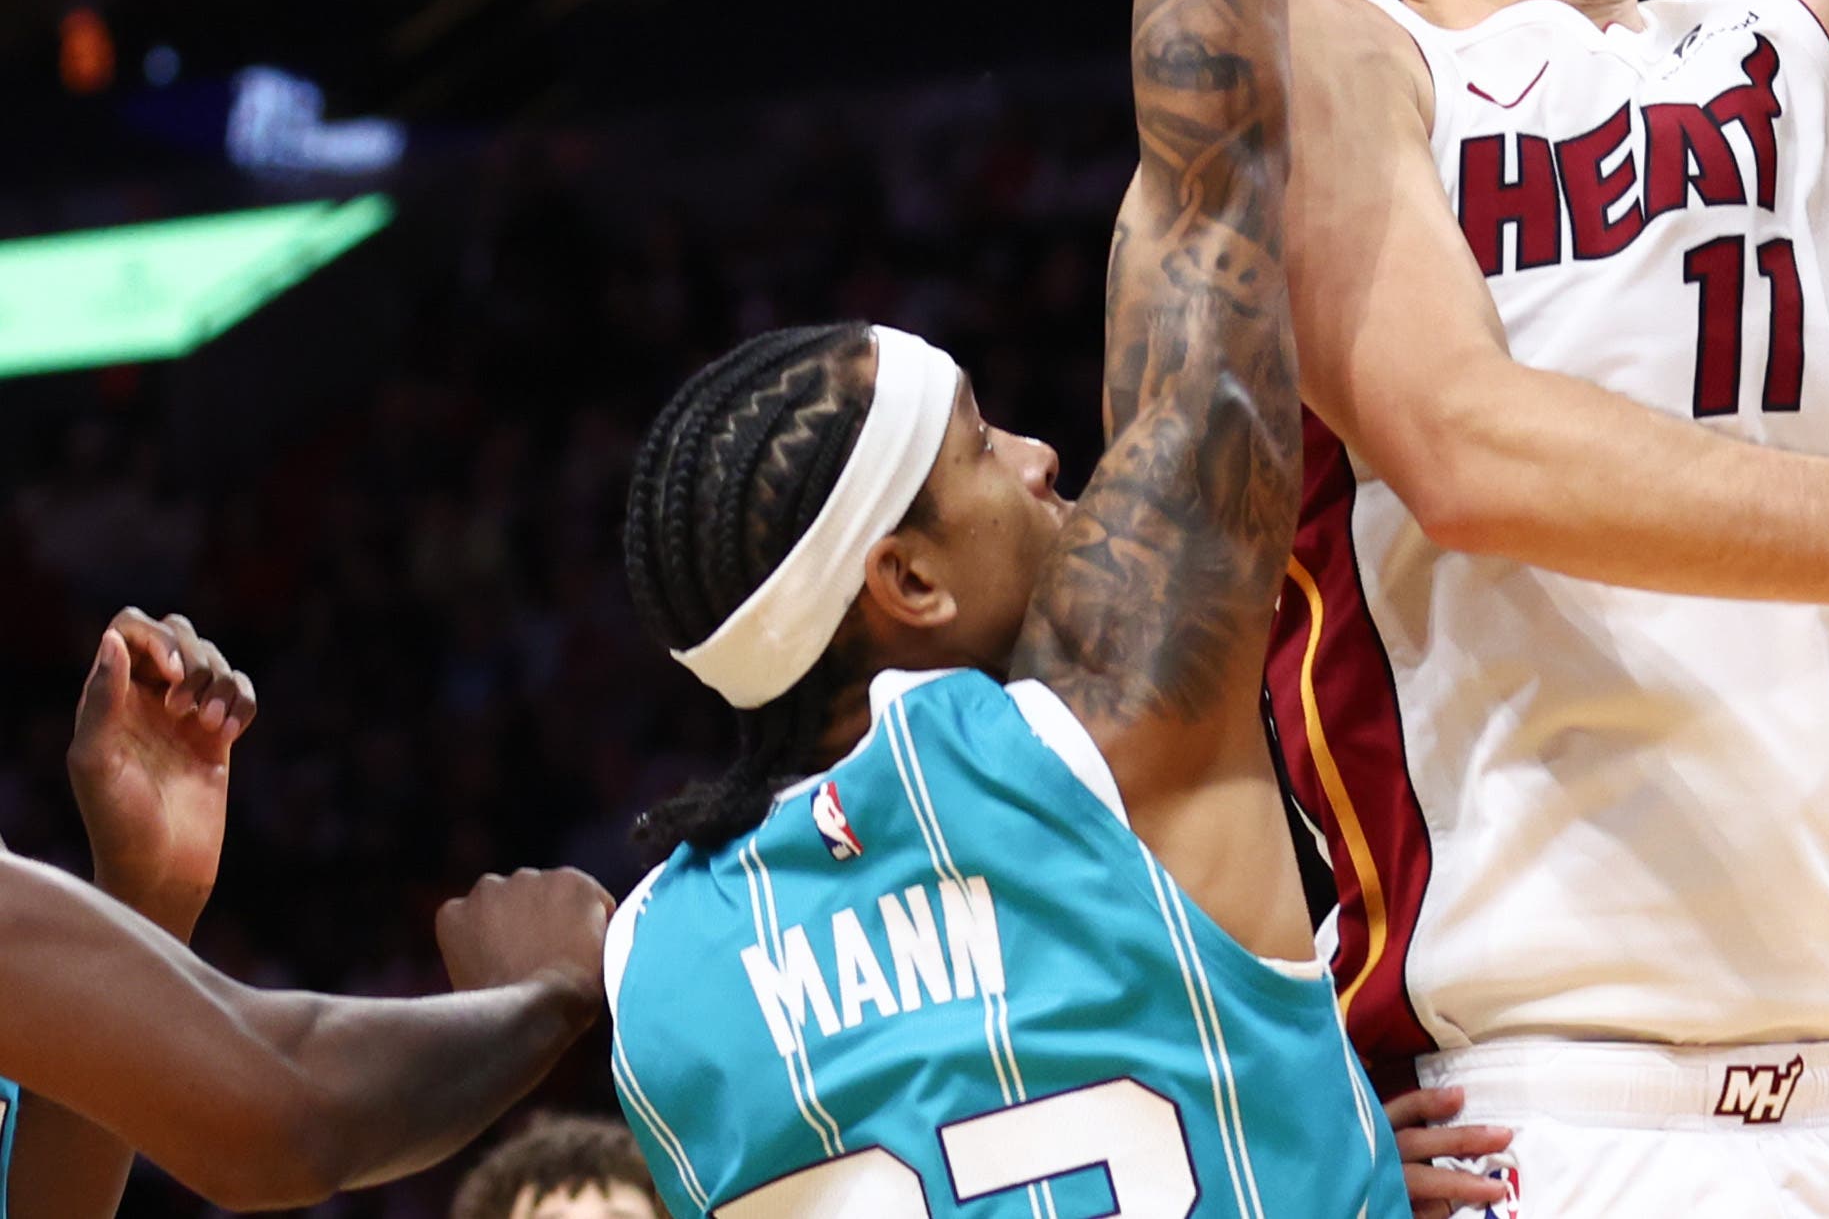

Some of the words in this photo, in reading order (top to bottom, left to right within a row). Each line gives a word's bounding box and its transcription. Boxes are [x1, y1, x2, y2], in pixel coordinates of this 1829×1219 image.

[1459, 31, 1782, 276] HEAT
[1683, 235, 1805, 418] 11
[739, 876, 1007, 1058] MANN
